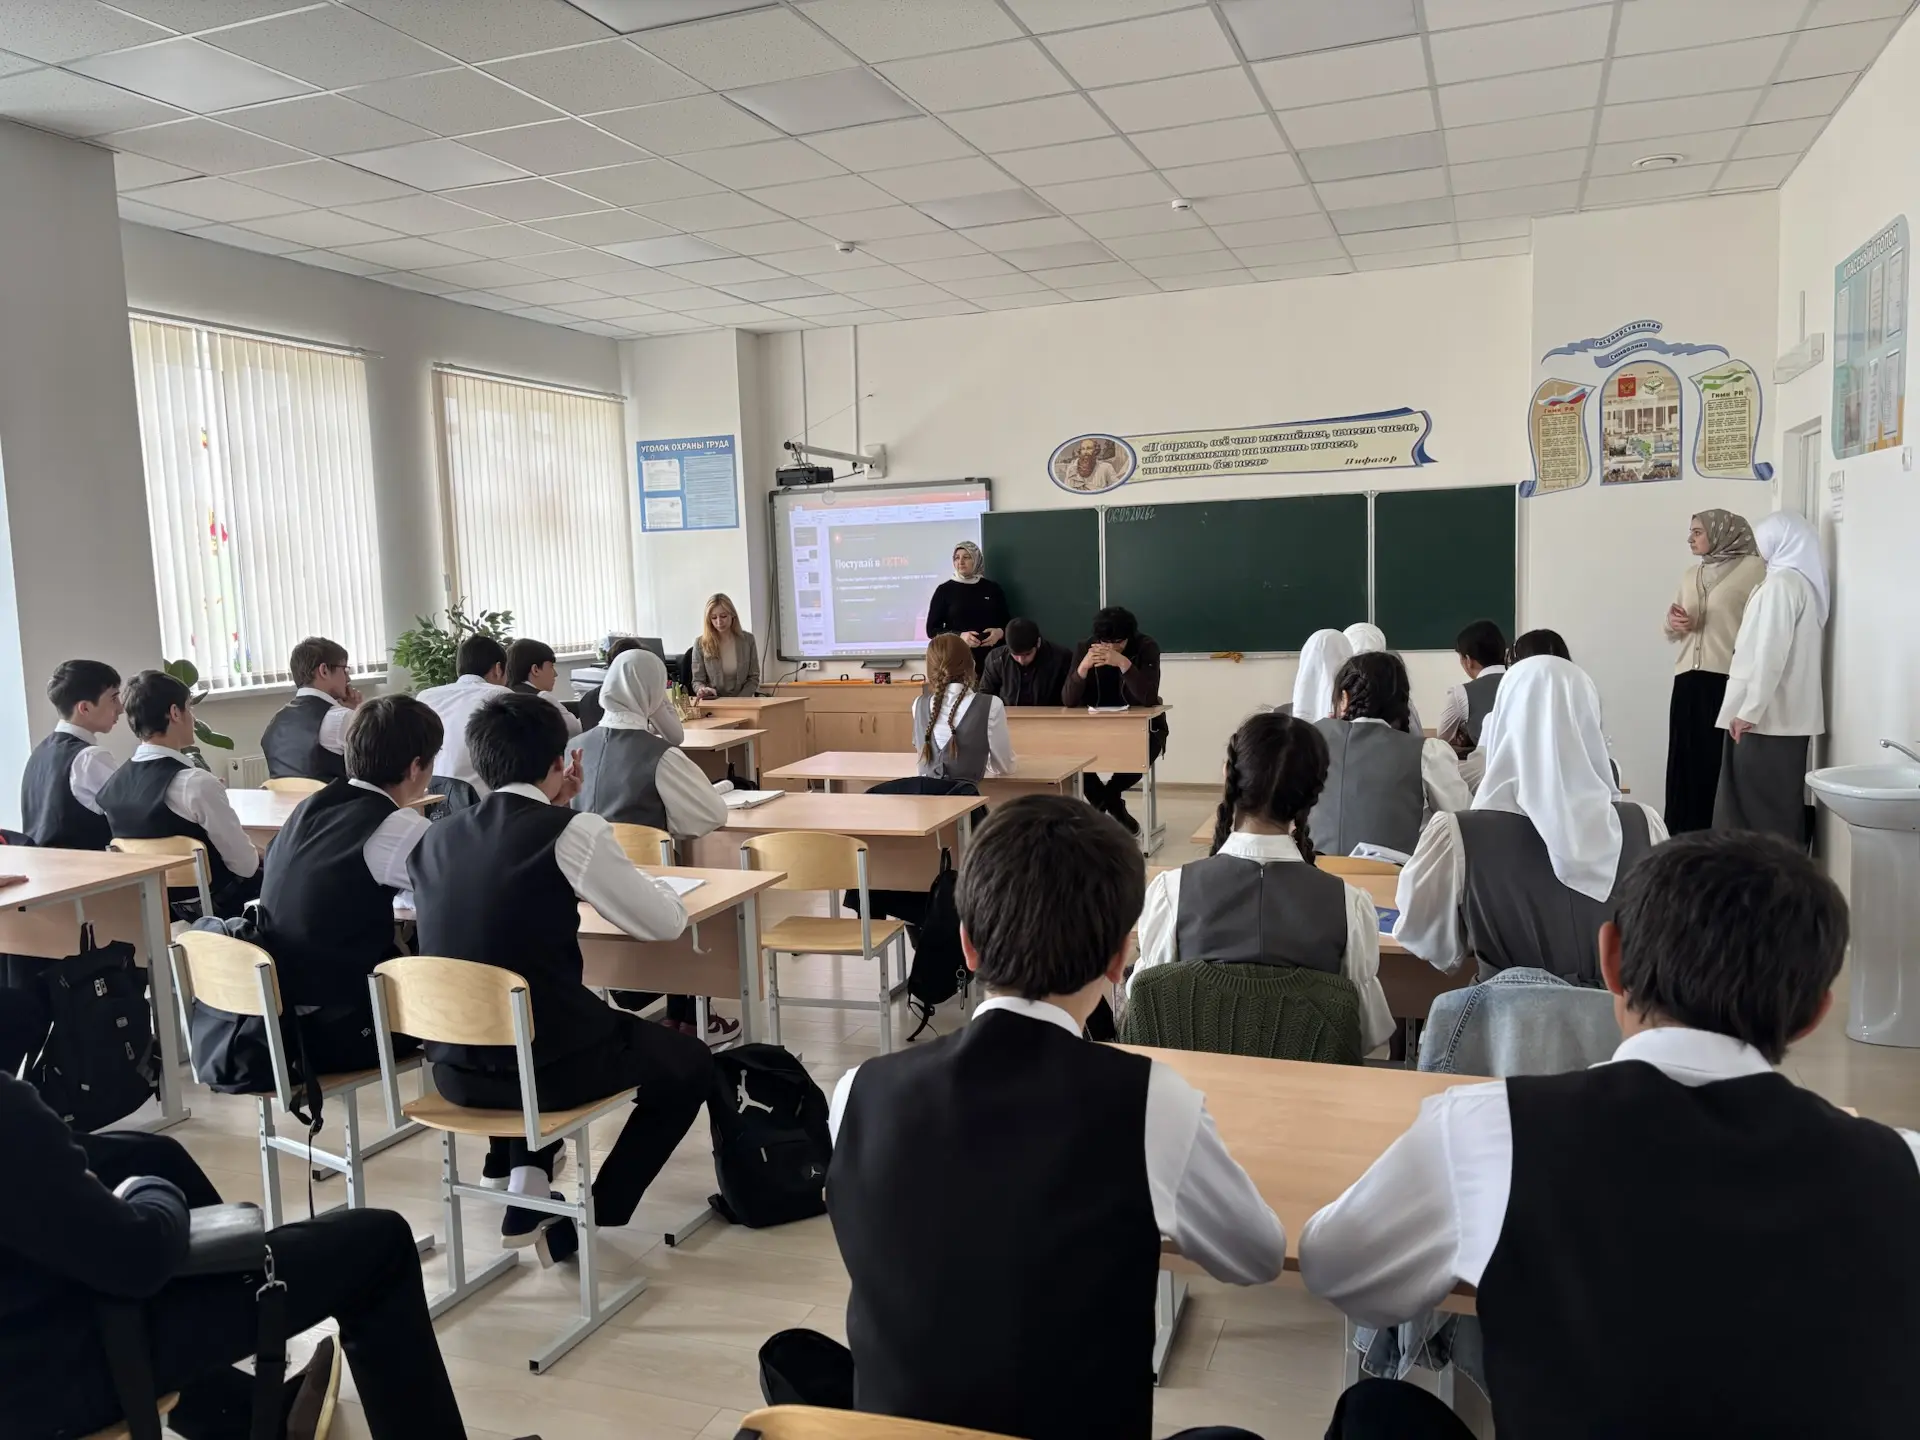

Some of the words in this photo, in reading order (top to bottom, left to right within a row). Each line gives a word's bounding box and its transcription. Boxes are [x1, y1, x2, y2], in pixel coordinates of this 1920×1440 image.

[1595, 322, 1660, 347] Государственная
[1610, 342, 1648, 360] Символика
[1231, 435, 1257, 445] что
[1332, 426, 1377, 437] имеет
[1378, 423, 1419, 433] число,
[640, 445, 670, 453] УГОЛОК
[672, 441, 704, 451] ОХРАНЫ
[706, 439, 730, 449] ТРУДА
[1142, 451, 1163, 464] ибо
[1165, 449, 1241, 463] невозможно
[1242, 447, 1259, 456] ни
[1260, 442, 1309, 455] понять
[1310, 440, 1358, 450] ничего,
[1142, 467, 1158, 475] ни
[1159, 463, 1212, 474] познать
[1213, 459, 1233, 470] без
[1234, 458, 1269, 468] него»
[1344, 455, 1398, 465] Пифагор
[835, 558, 874, 570] Поступай
[875, 559, 881, 568] в
